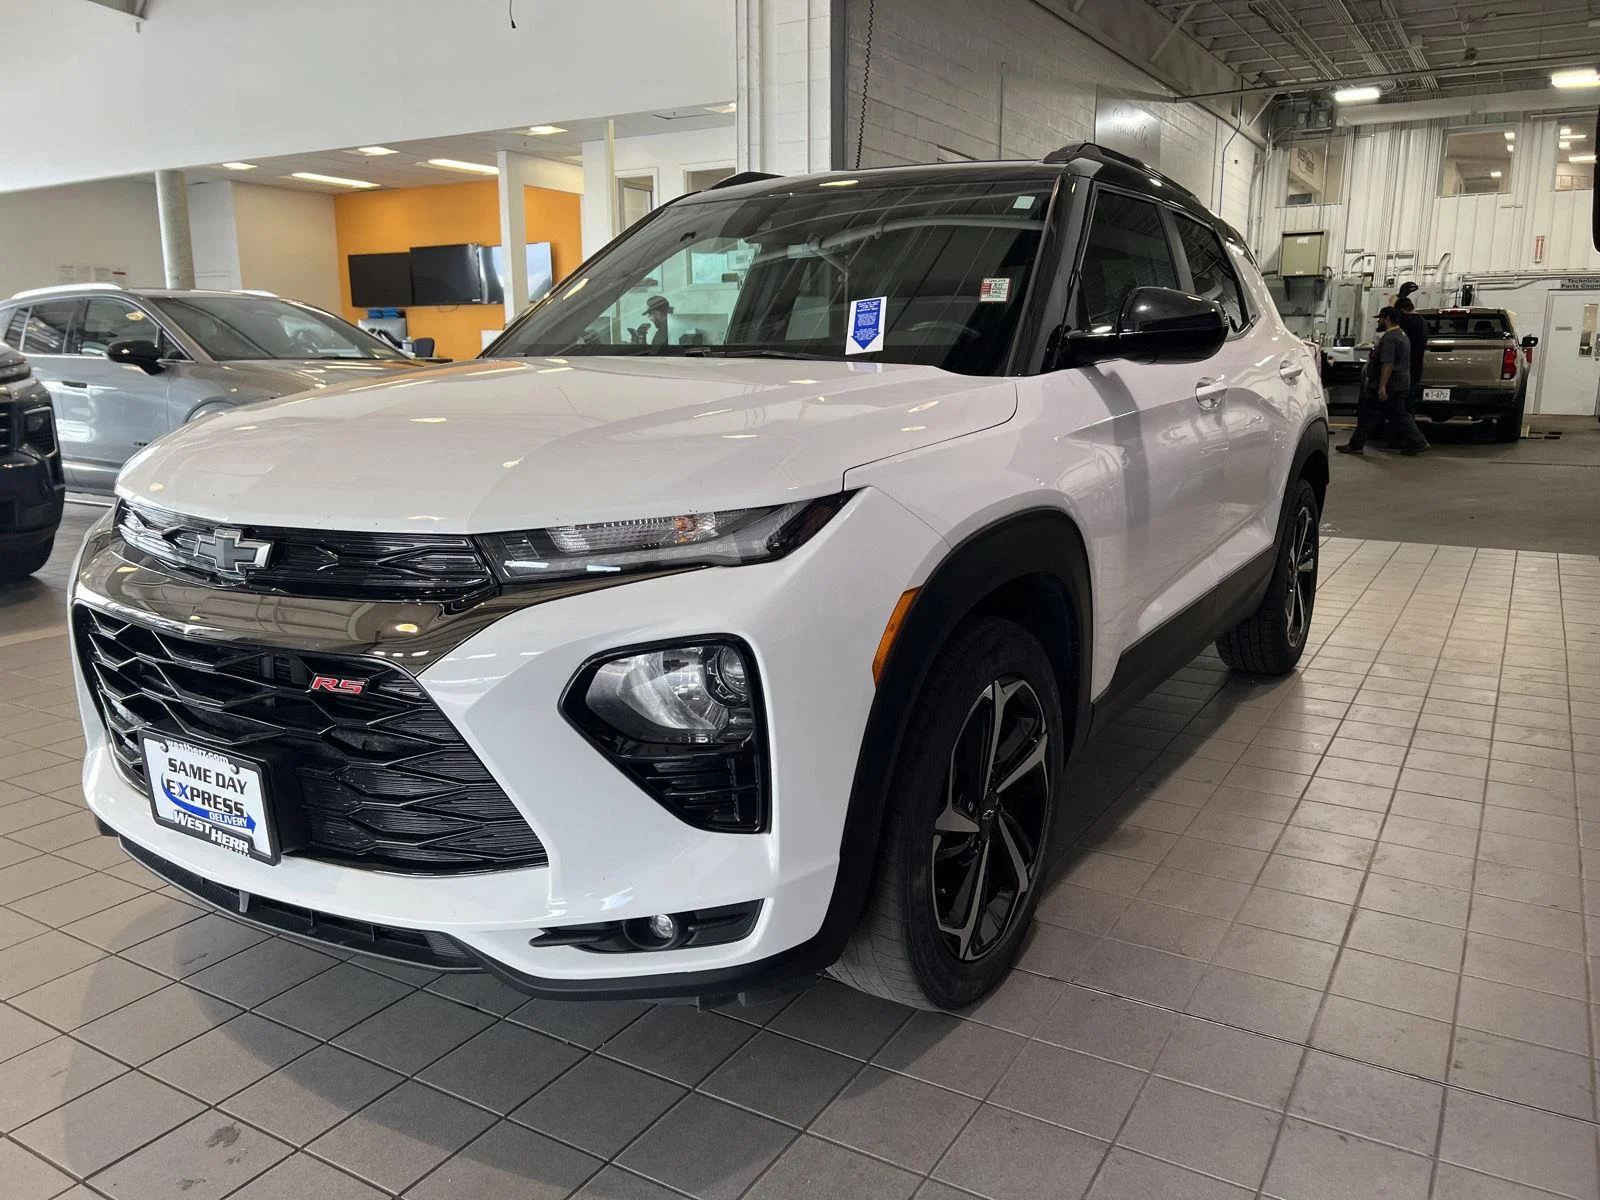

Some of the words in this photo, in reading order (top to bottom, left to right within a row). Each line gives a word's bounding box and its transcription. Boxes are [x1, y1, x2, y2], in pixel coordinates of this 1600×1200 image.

[311, 676, 365, 695] RS
[165, 739, 230, 764] westherr.com
[168, 757, 212, 785] SAME
[215, 771, 248, 796] DAY
[166, 778, 245, 818] EXPRESS
[208, 811, 248, 828] DELIVERY
